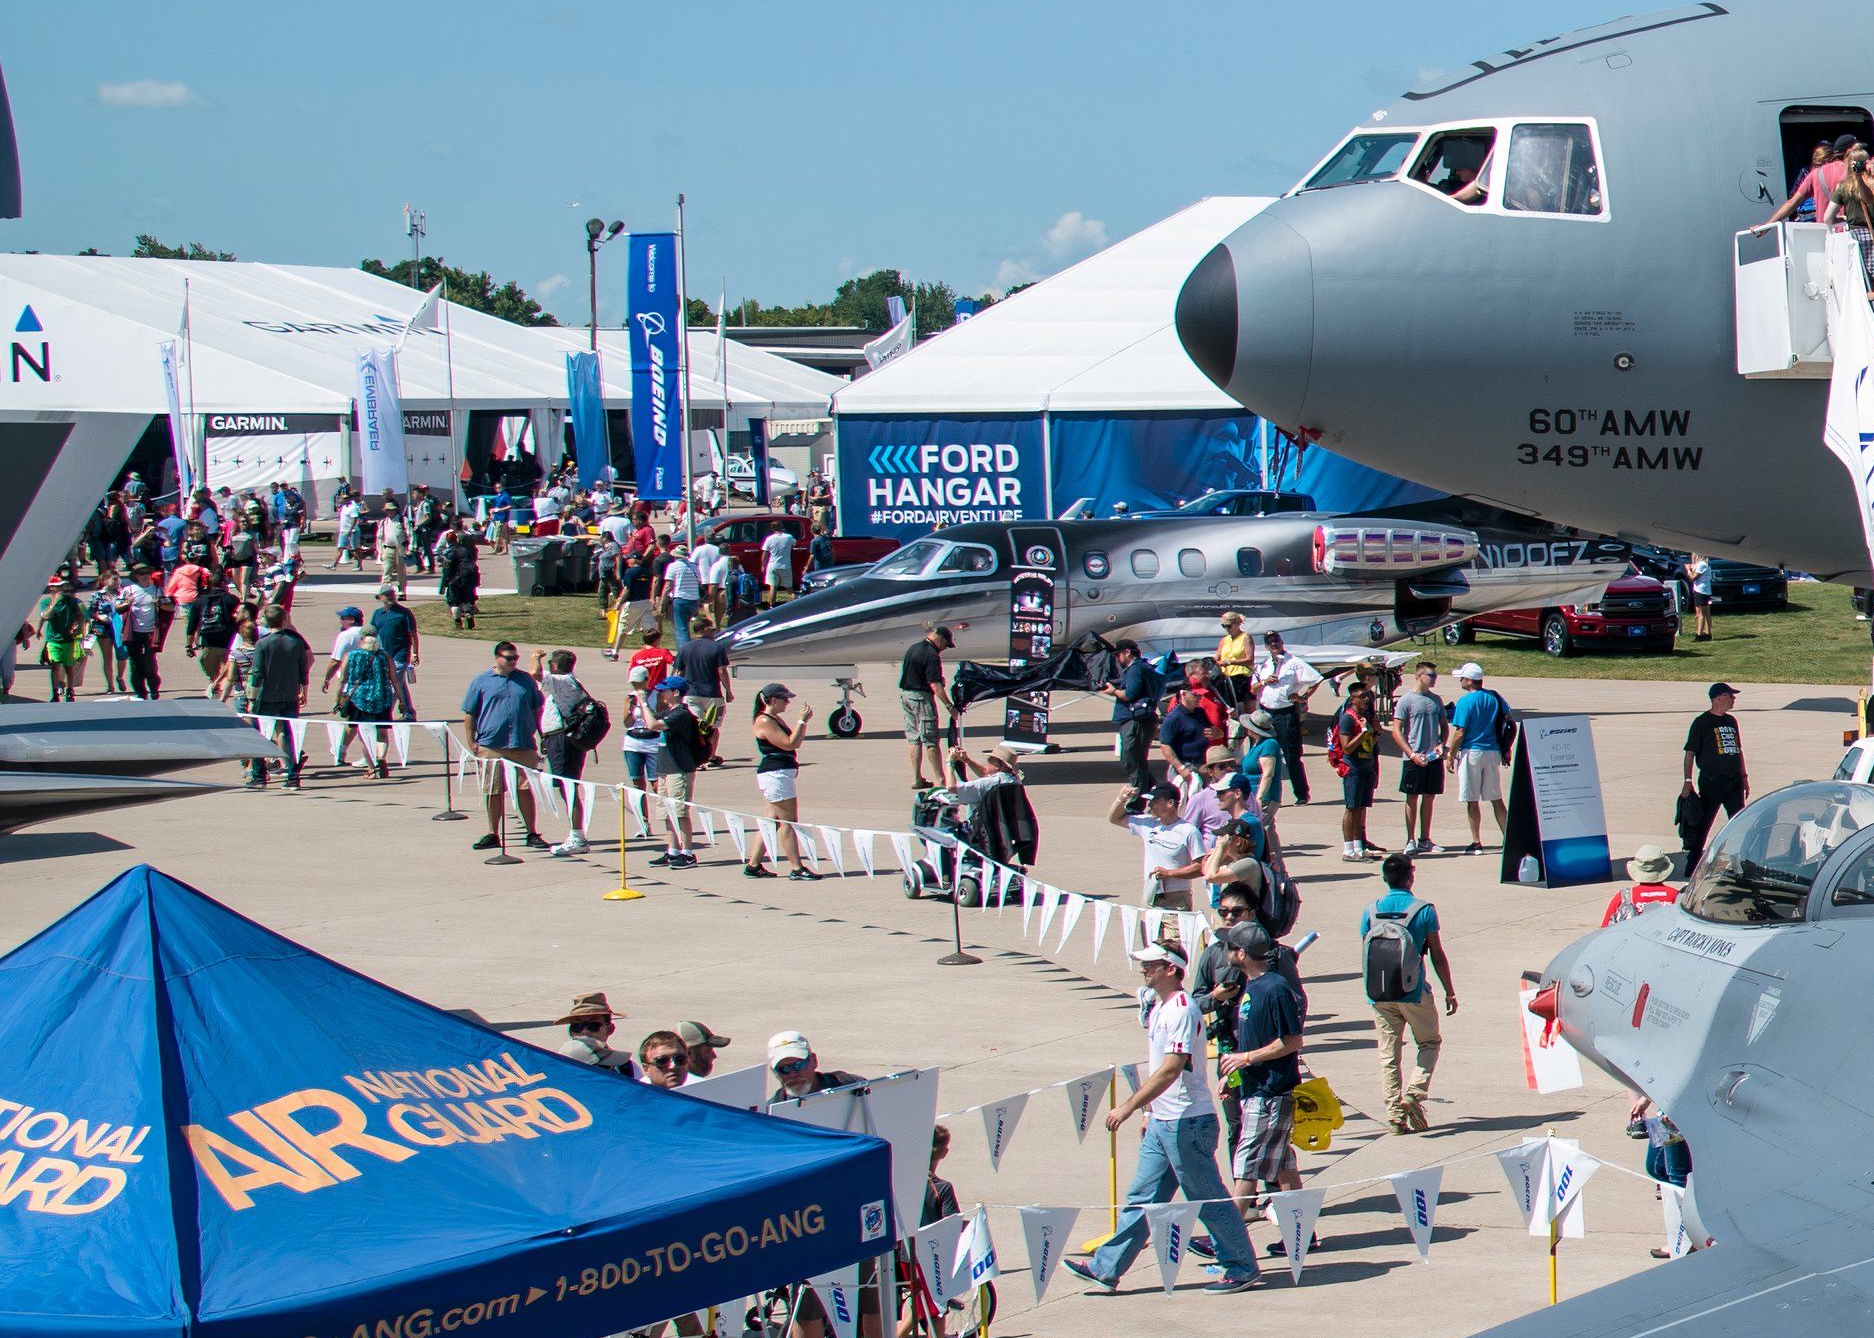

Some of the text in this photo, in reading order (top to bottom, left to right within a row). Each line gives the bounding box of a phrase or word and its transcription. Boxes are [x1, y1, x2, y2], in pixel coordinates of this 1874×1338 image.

[649, 343, 668, 447] BOEING
[211, 414, 287, 431] GARMIN
[403, 414, 448, 431] ARMIN
[1599, 409, 1691, 437] AMW
[920, 444, 1019, 473] FORD
[1612, 444, 1703, 470] AMW
[868, 477, 1023, 507] HANGAR
[1667, 926, 1736, 958] CAPT ROCKY JONES
[343, 1051, 547, 1104] NATIONAL
[386, 1087, 593, 1147] GUARD
[1080, 1092, 1089, 1131] BOEING
[184, 1087, 420, 1212] AIR
[994, 1119, 1004, 1158] BOEING
[1556, 1163, 1573, 1203] 100
[1415, 1188, 1428, 1227] 100
[556, 1203, 827, 1304] 1-800-TO-GO-ANG
[1039, 1240, 1050, 1283] BOEING
[1170, 1222, 1181, 1265] 100
[934, 1253, 944, 1297] BOEING
[972, 1250, 997, 1281] 00
